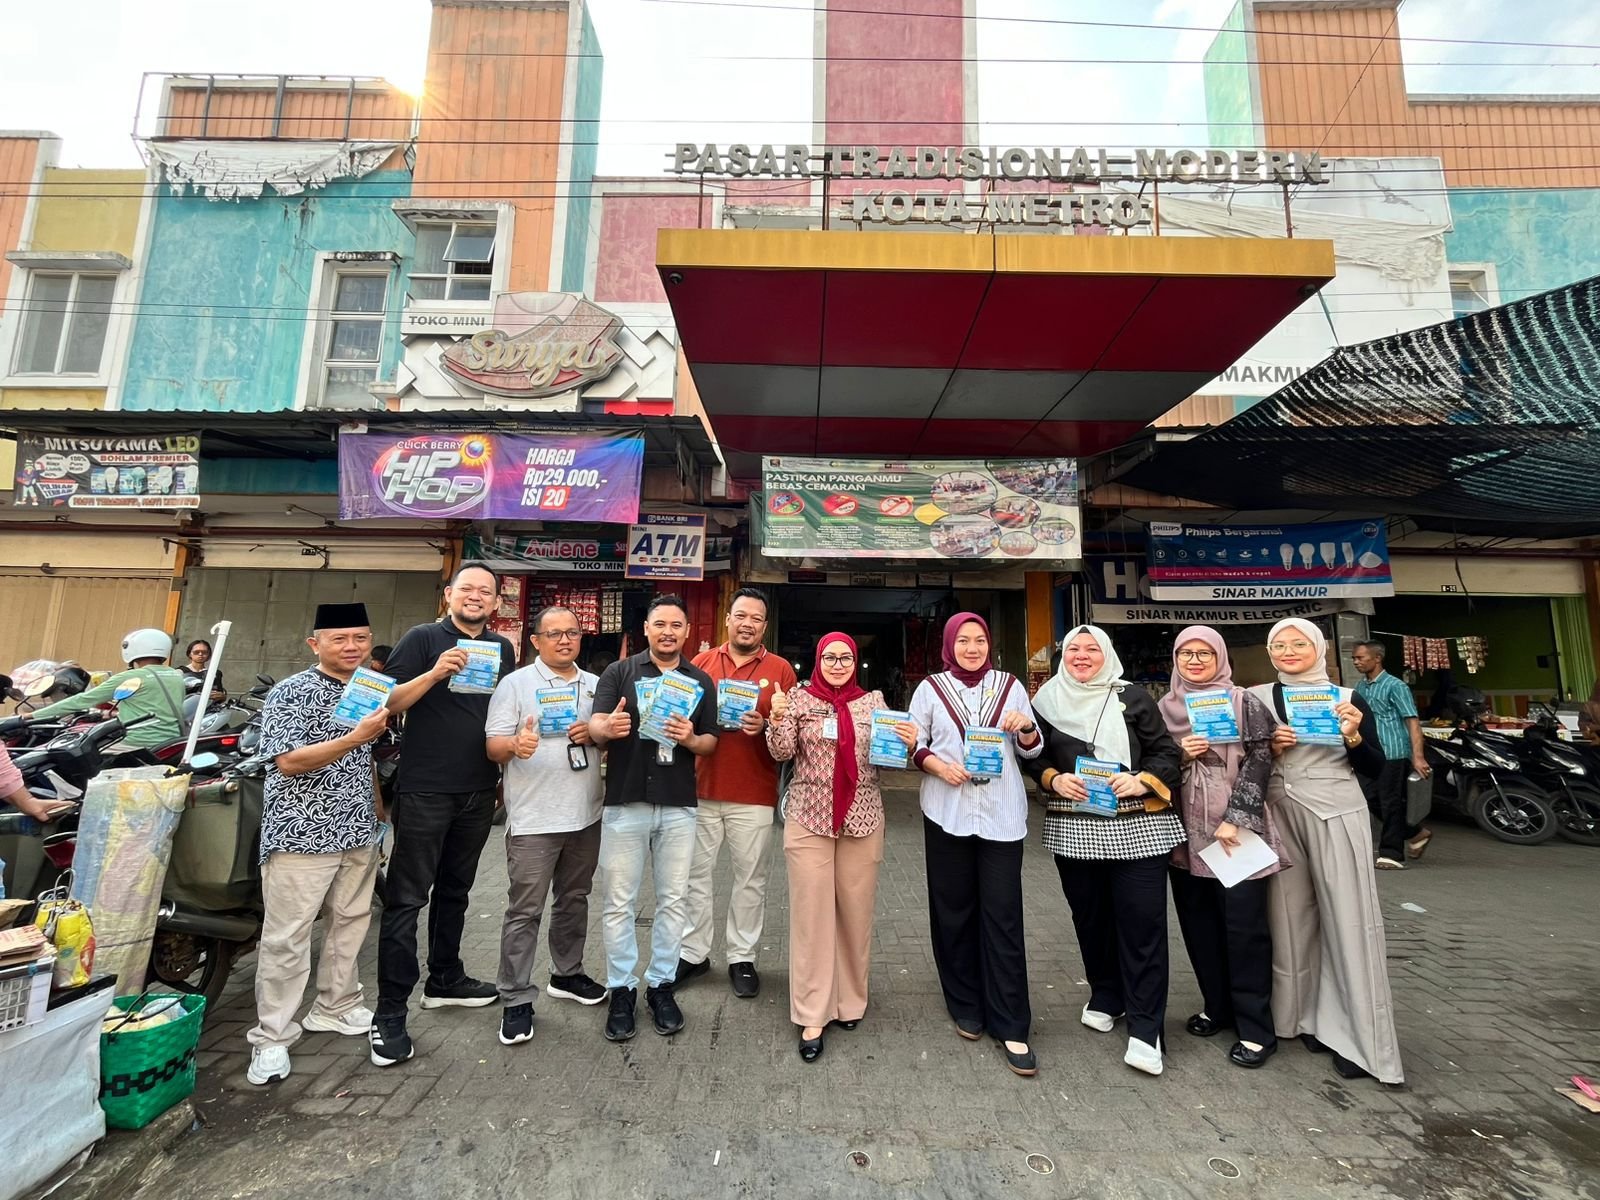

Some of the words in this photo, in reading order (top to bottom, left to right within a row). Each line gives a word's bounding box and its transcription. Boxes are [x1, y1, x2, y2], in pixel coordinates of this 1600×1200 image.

[674, 143, 810, 176] PASAR
[828, 146, 1121, 181] TRADISIONAL
[1135, 149, 1322, 184] MODERN
[852, 188, 971, 223] KOTA
[986, 192, 1143, 227] METRO
[408, 315, 448, 326] TOKO
[453, 316, 485, 327] MINI
[464, 330, 604, 388] Surya
[44, 437, 162, 451] MITSUYAMA
[165, 436, 199, 451] LED
[397, 441, 427, 450] CLICK
[431, 440, 463, 450] BERRY
[100, 454, 143, 462] BOHLAM
[146, 454, 190, 462] PREMIER
[526, 448, 575, 467] HARGA
[523, 468, 608, 489] Rp29.000,-
[765, 473, 827, 483] PASTIKAN
[829, 474, 902, 484] PANGANMU
[384, 476, 484, 504] HOP
[765, 482, 803, 491] BEBAS
[805, 483, 866, 492] CEMARAN
[521, 489, 541, 506] ISI
[543, 489, 566, 507] 20
[1185, 527, 1222, 537] Philips
[630, 532, 702, 557] ATM
[572, 561, 602, 570] TOKO
[604, 561, 624, 571] MIN
[1212, 587, 1258, 599] SINAR
[1261, 586, 1328, 598] MAKMUR
[1126, 609, 1169, 620] SINAR
[1174, 610, 1236, 621] MAKMUR
[1242, 602, 1322, 620] ELECTRIC
